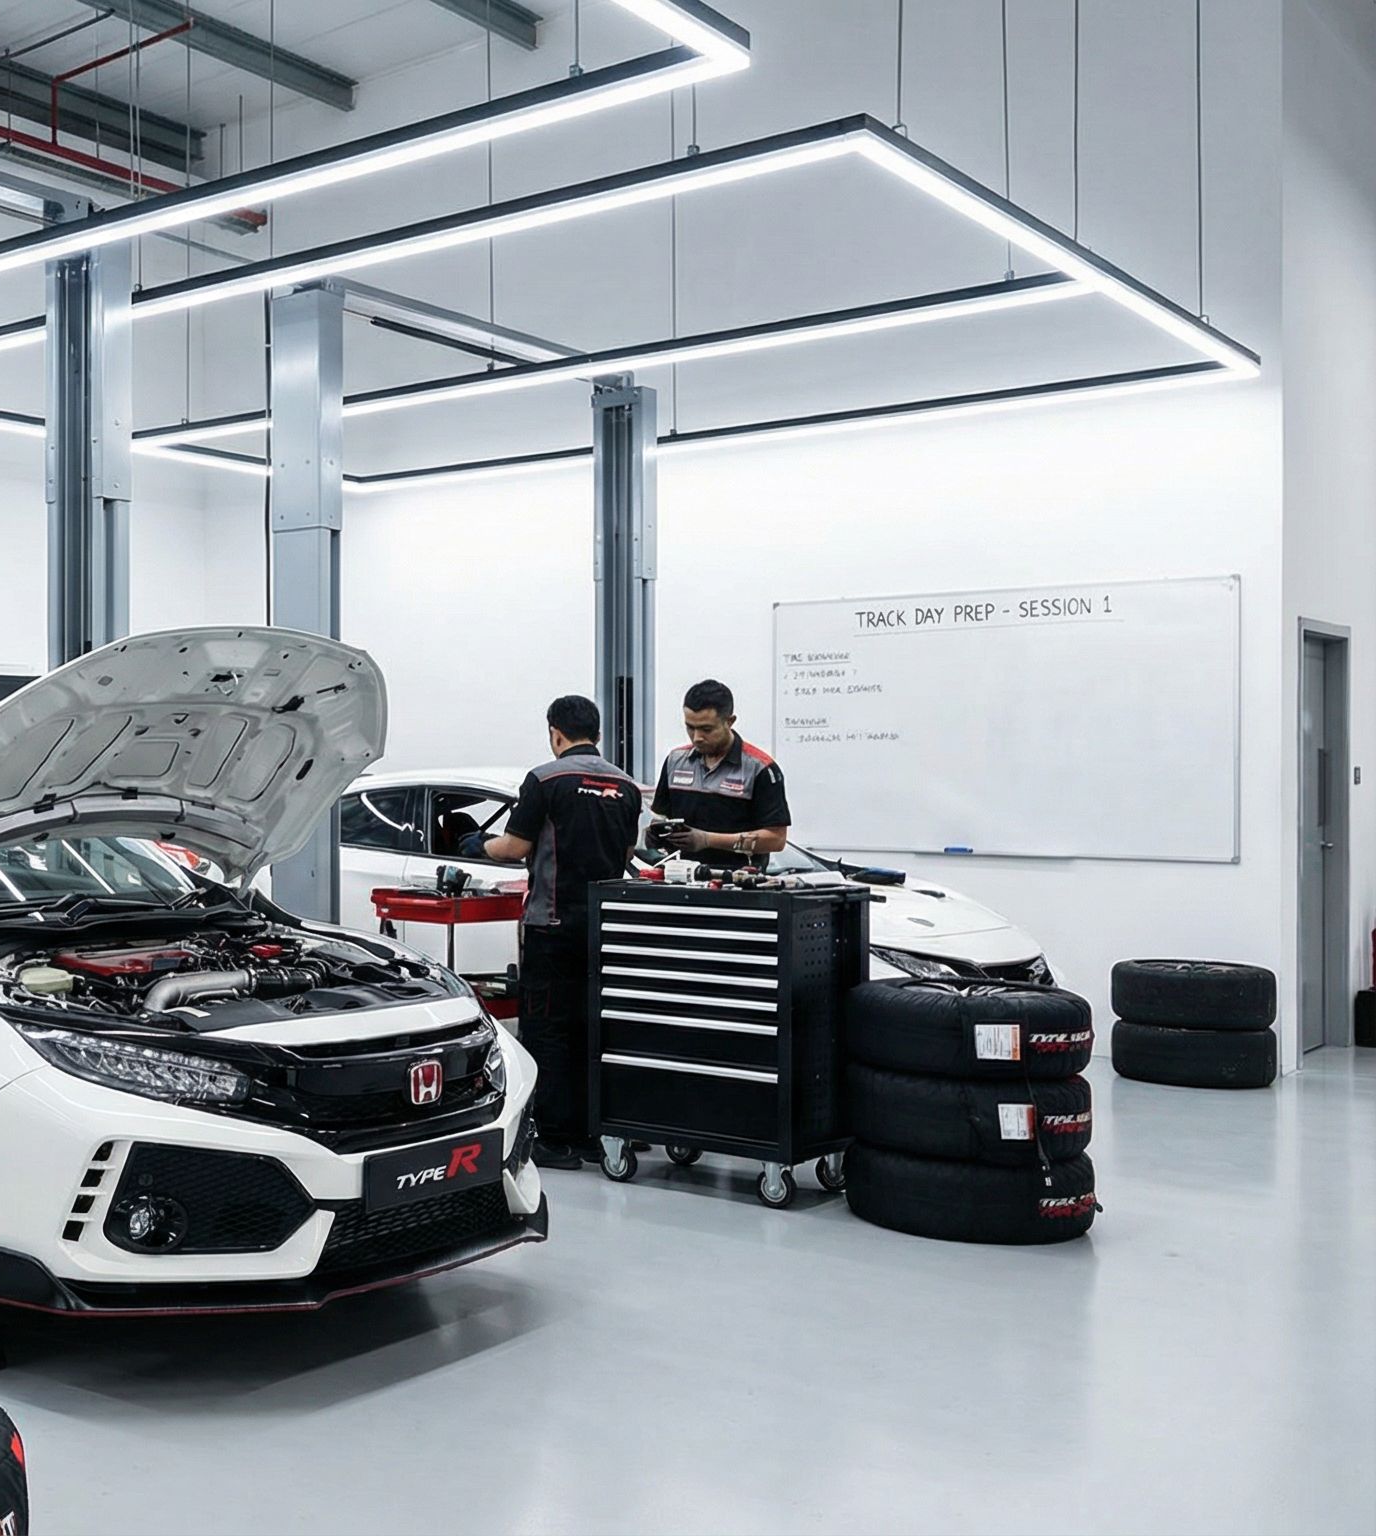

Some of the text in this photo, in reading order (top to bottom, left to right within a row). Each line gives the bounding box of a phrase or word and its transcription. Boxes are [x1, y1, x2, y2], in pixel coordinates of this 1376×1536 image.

[855, 610, 906, 629] TRACK
[915, 607, 944, 625] DAY
[954, 603, 995, 623] PREP
[1019, 598, 1092, 618] SESSION
[1103, 595, 1112, 613] 1
[396, 1144, 481, 1190] TYPE R
